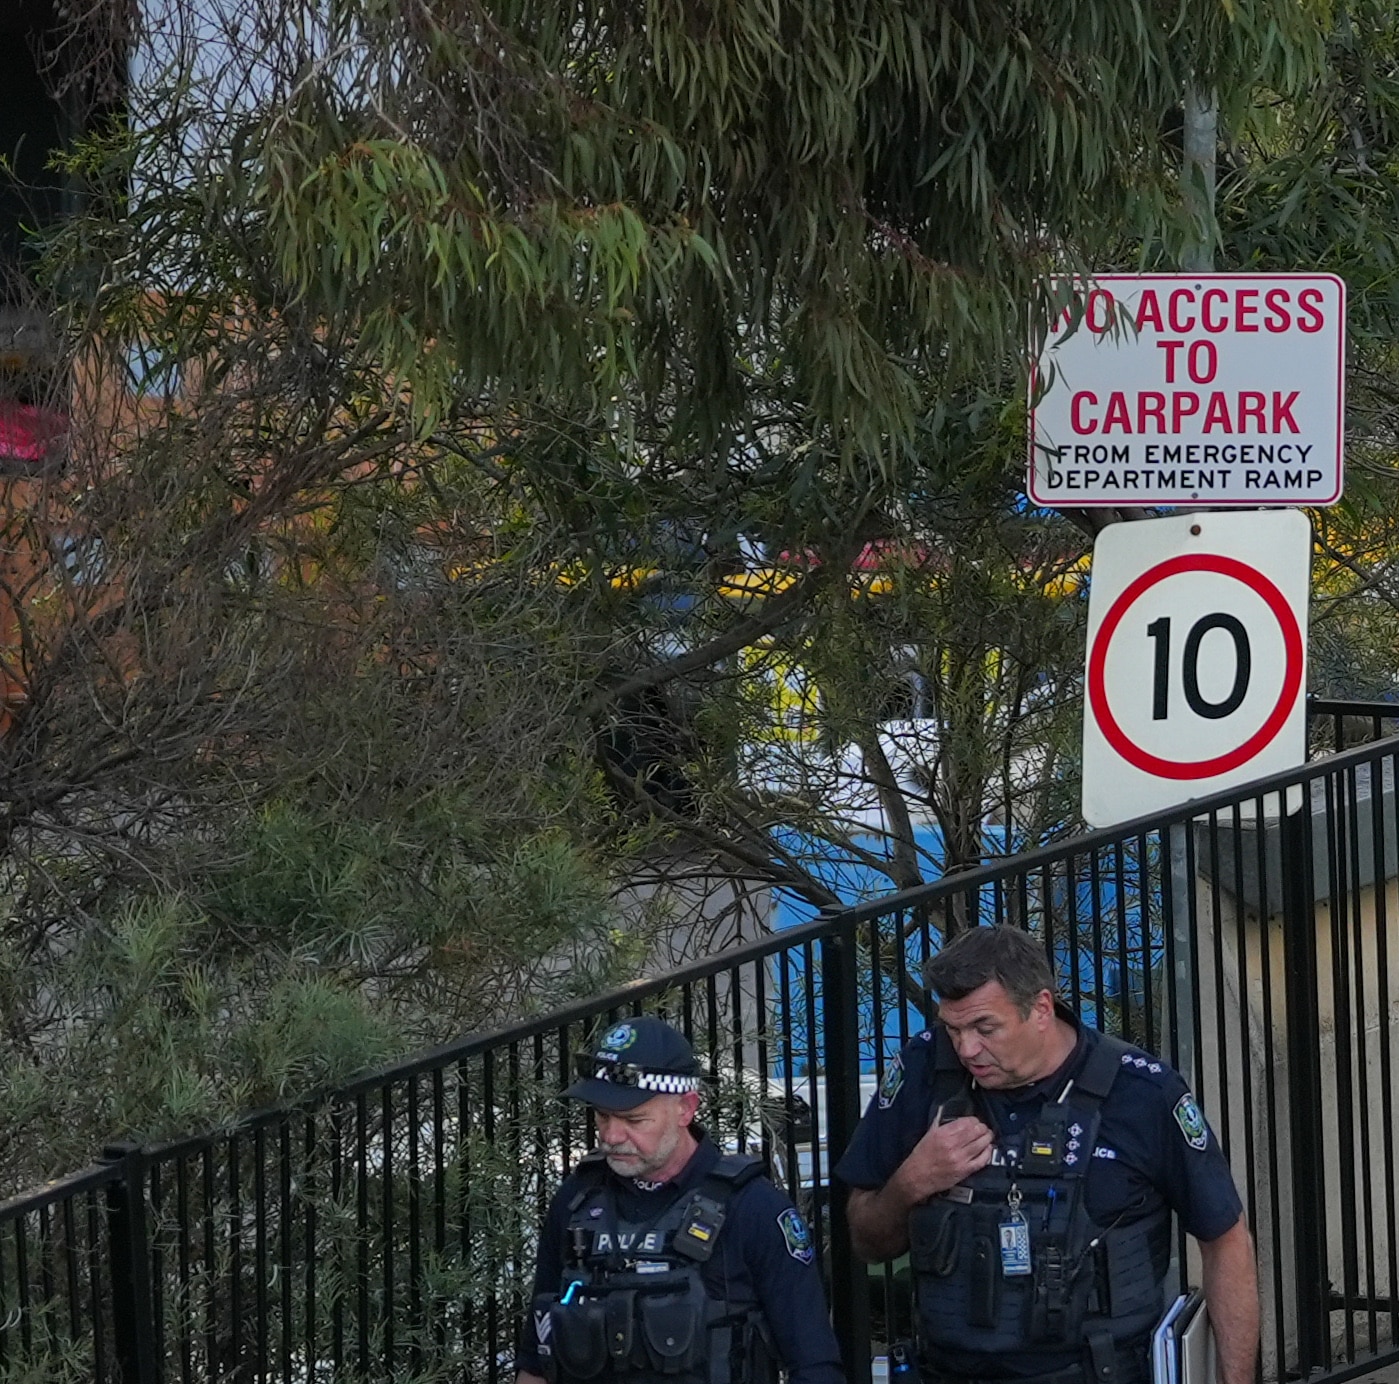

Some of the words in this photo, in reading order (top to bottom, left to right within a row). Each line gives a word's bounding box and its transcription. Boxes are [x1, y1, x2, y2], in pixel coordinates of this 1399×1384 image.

[1050, 288, 1115, 334] O
[1135, 287, 1325, 334] ACCESS
[1156, 339, 1219, 385] TO
[1070, 390, 1301, 435] CARPARK
[1057, 444, 1130, 465] FROM
[1145, 444, 1313, 465] EMERGENCY
[1048, 469, 1235, 491] DEPARTMENT
[1245, 469, 1324, 491] RAMP
[1145, 612, 1251, 722] 10
[1092, 1146, 1116, 1160] ICE
